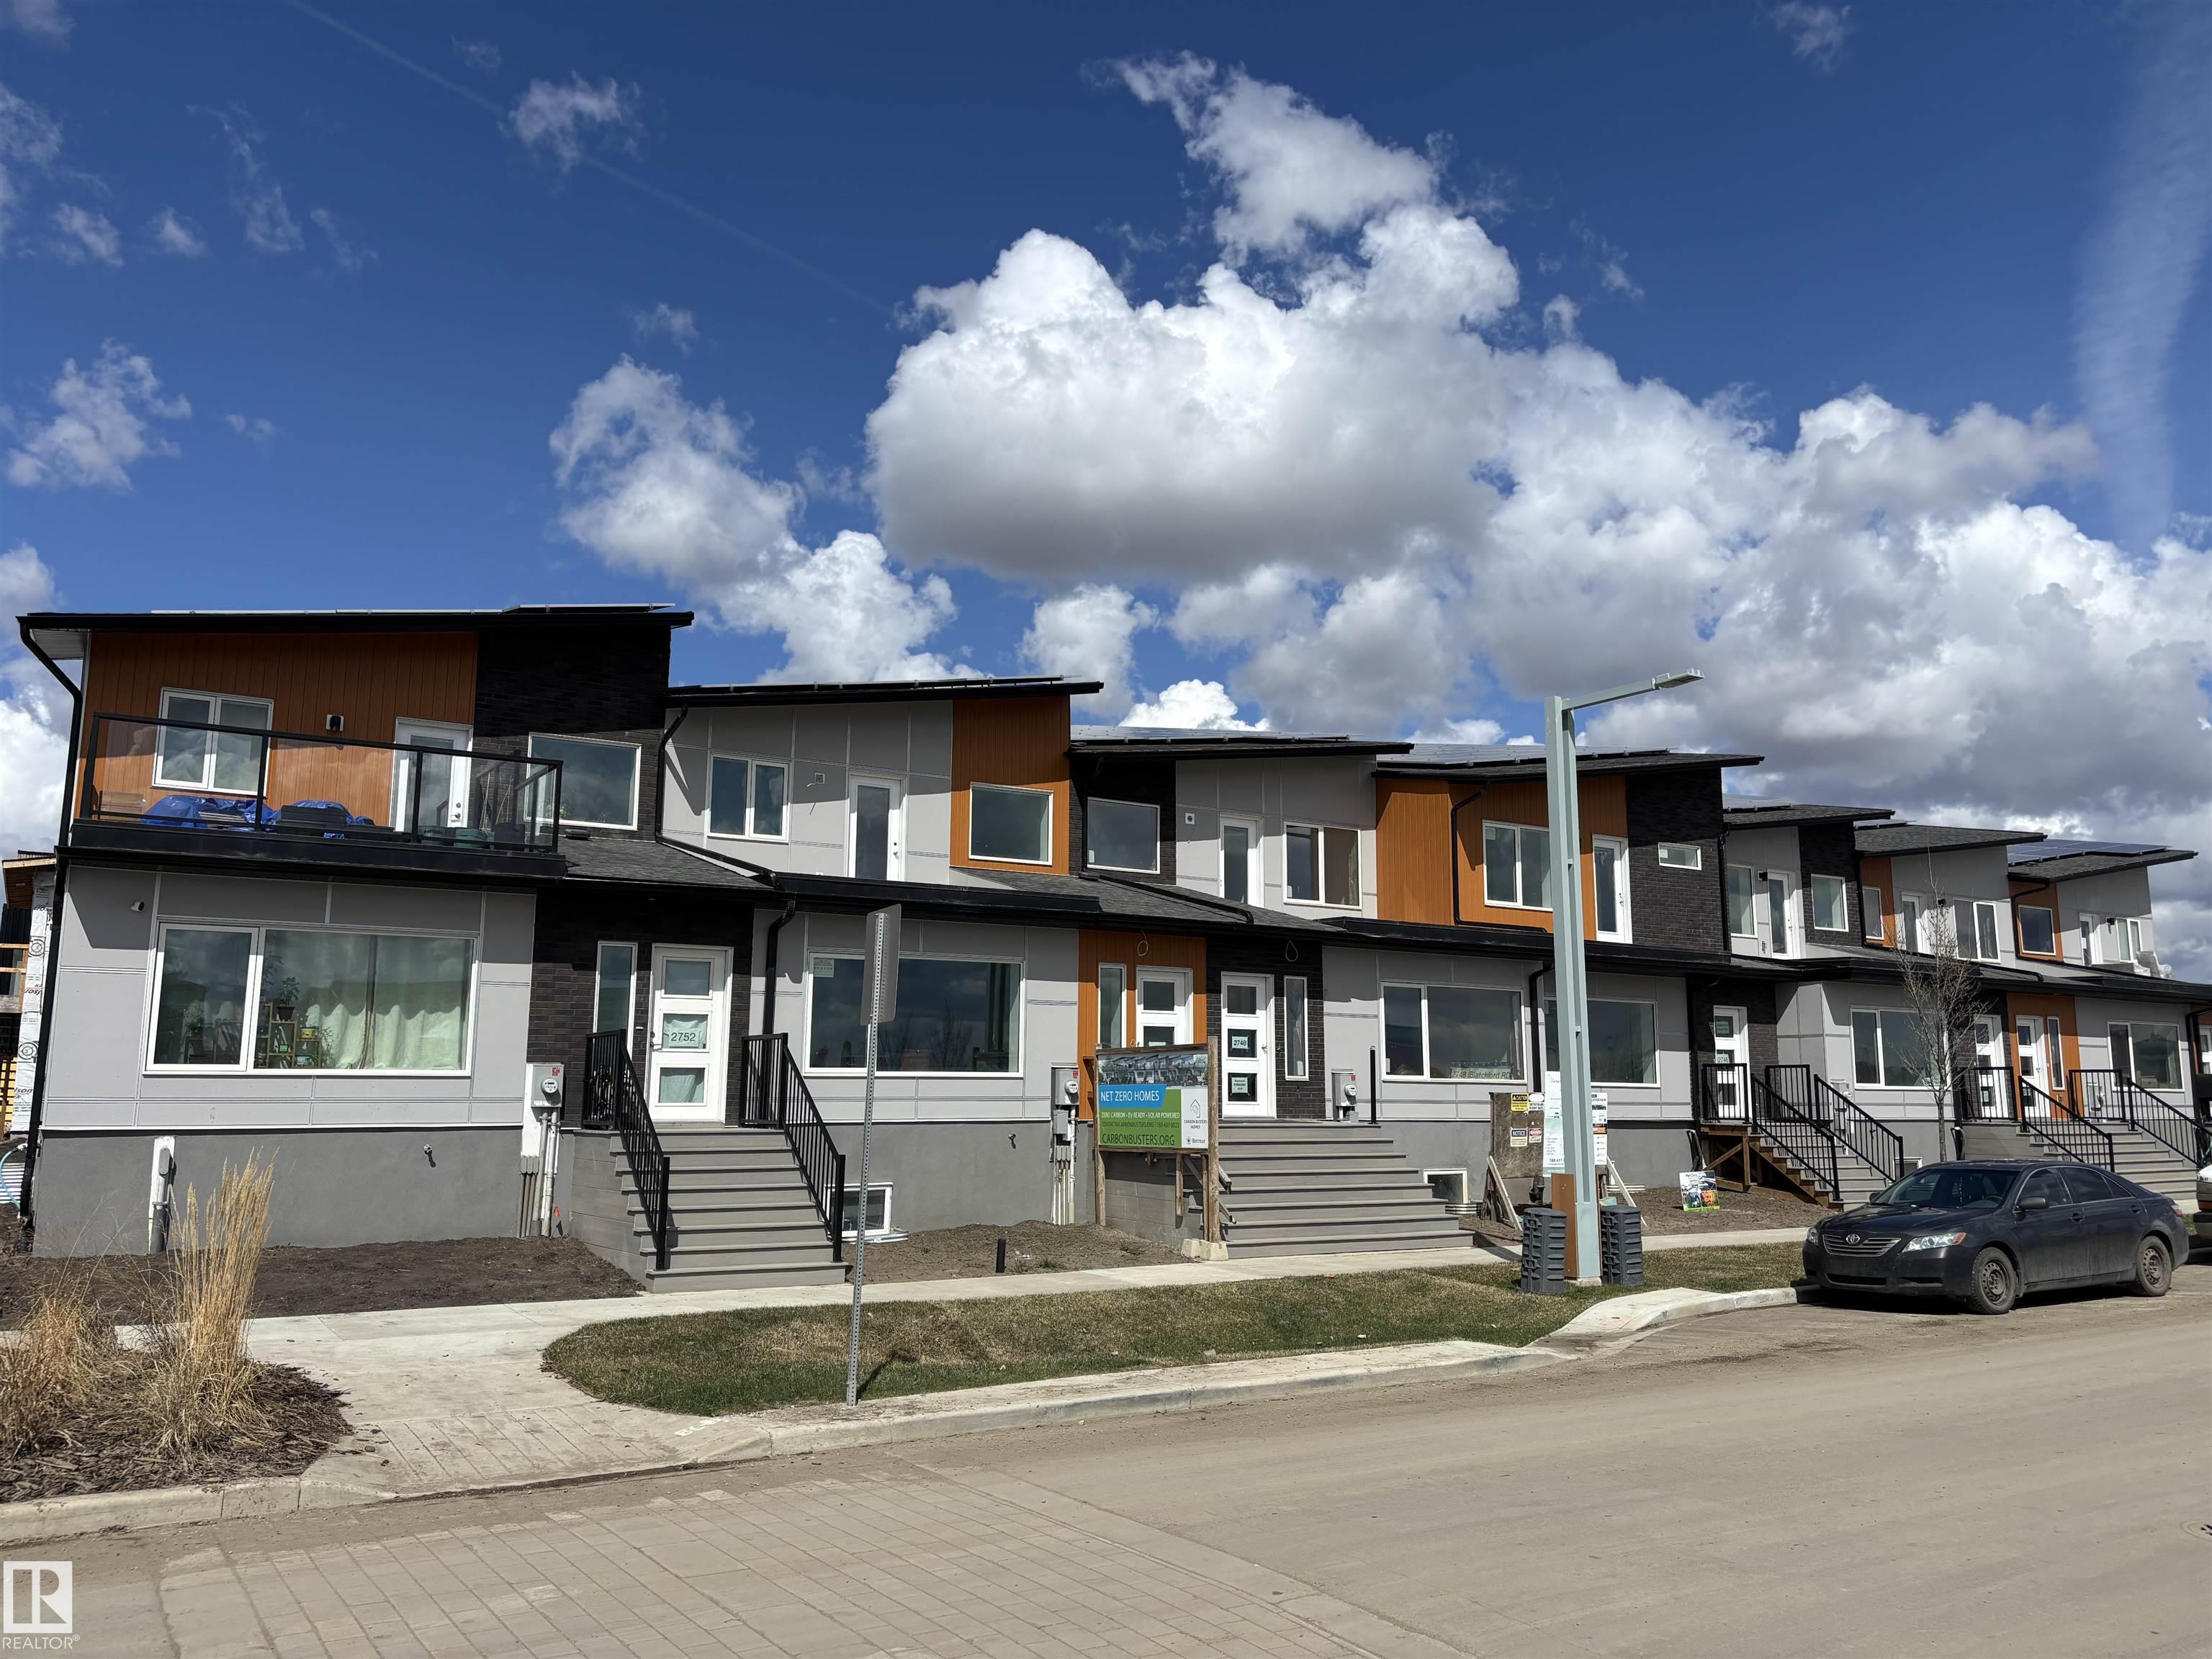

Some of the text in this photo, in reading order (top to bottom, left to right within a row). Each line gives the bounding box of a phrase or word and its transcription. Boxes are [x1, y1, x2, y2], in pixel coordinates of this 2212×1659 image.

[671, 1033, 696, 1041] 2752
[1469, 1071, 1501, 1079] Blatchford
[1101, 1090, 1159, 1102] NET ZERO HOMES
[1102, 1133, 1175, 1146] CARBONBUSTERS.ORG
